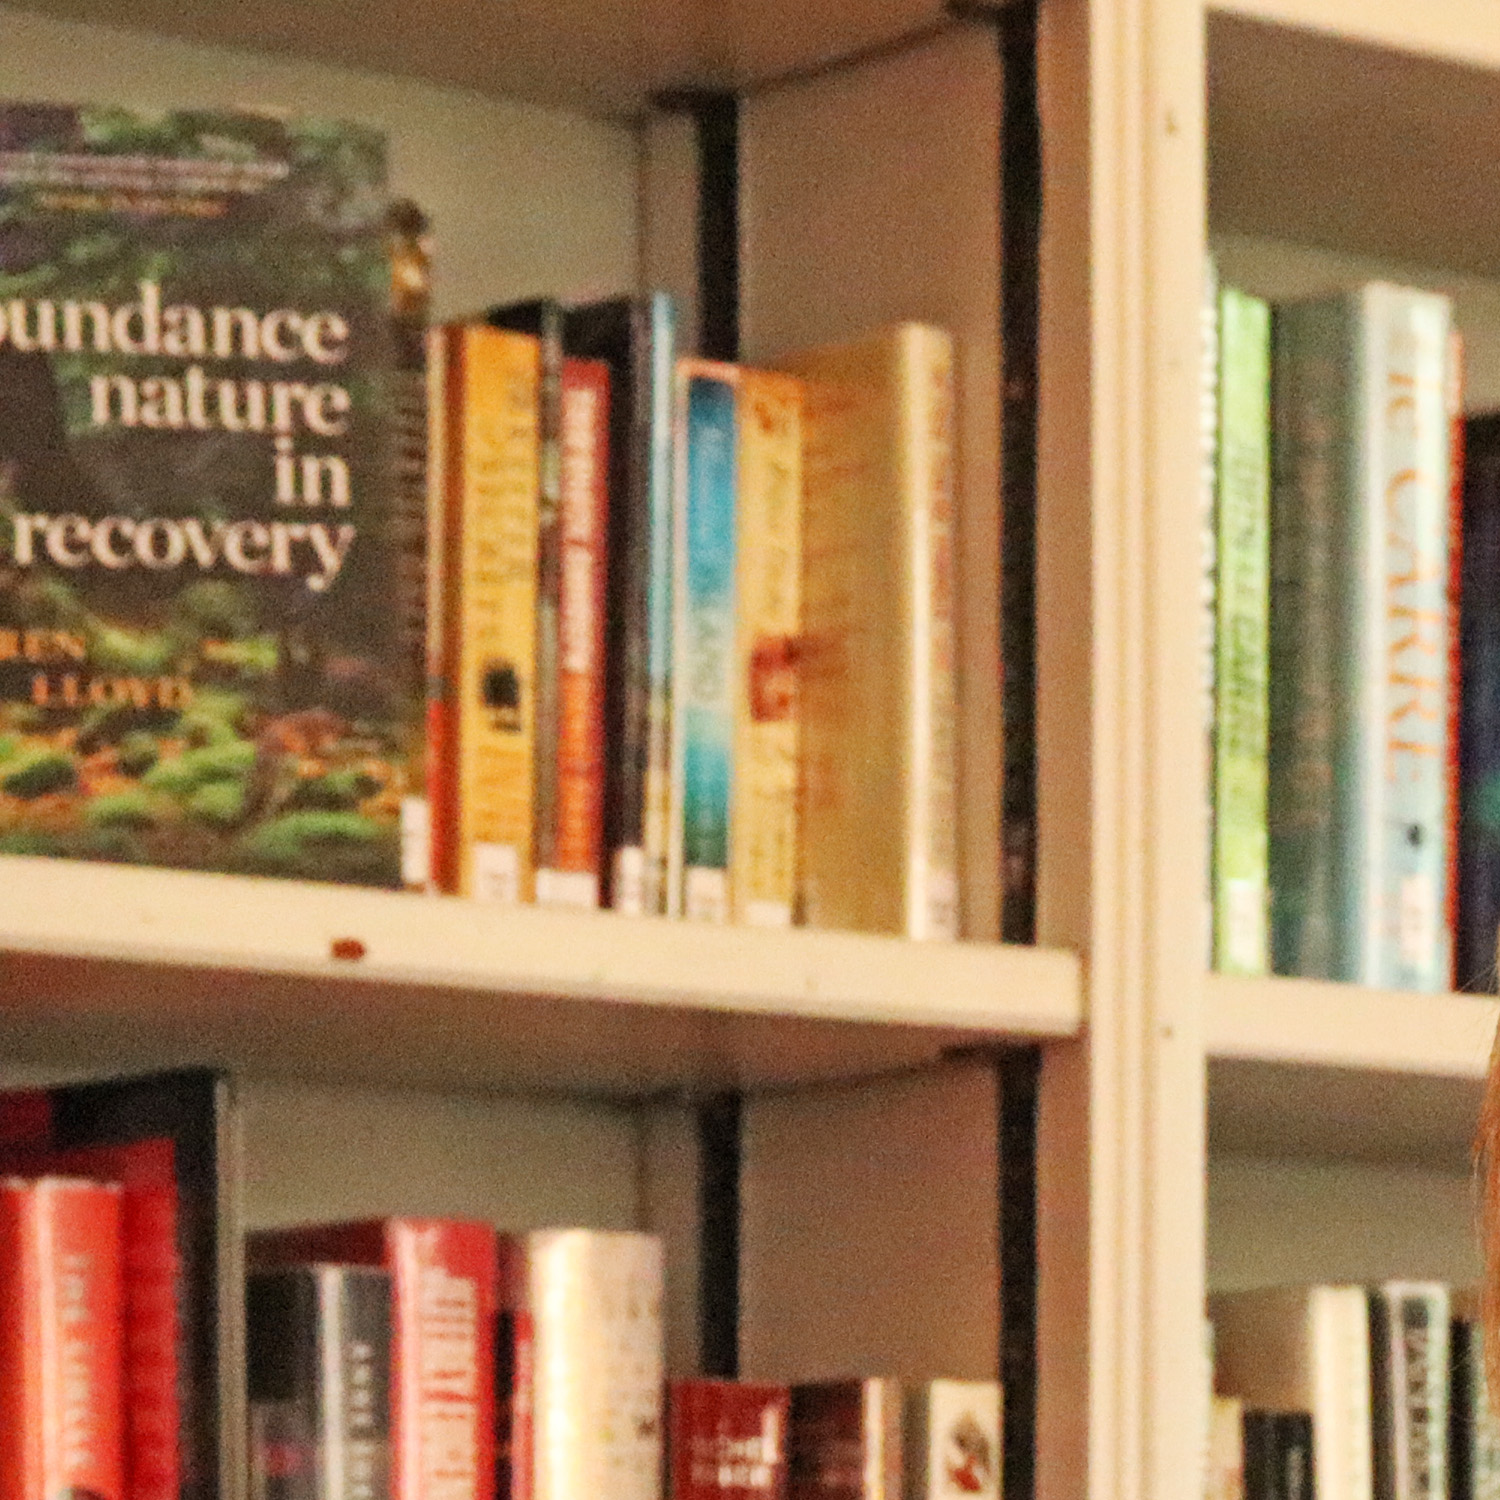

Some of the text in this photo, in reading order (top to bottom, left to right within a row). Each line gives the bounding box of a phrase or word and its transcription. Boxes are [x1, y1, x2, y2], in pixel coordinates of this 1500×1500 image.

[90, 365, 351, 436] nature
[275, 434, 351, 506] in
[12, 510, 355, 592] recovery
[31, 672, 193, 707] LLOYD
